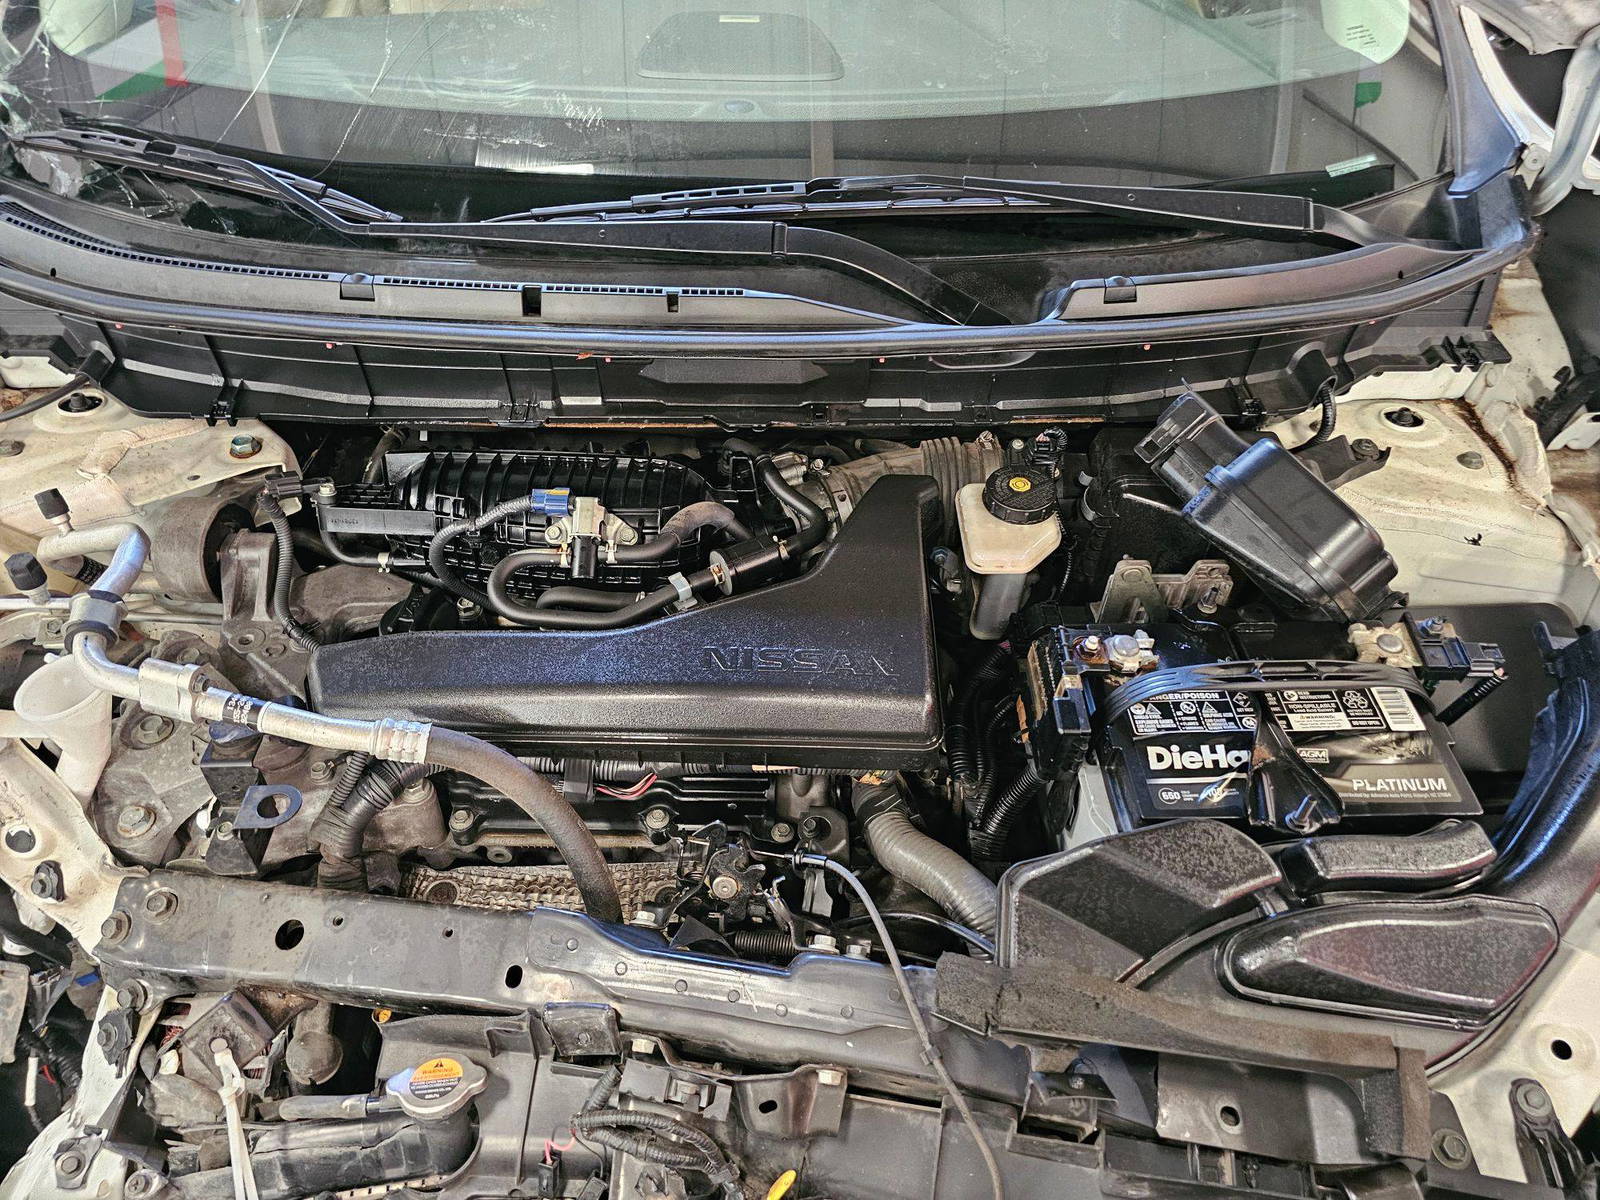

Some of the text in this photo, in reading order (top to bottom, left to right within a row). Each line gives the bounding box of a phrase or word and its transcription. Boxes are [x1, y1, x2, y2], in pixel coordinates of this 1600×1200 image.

[701, 646, 900, 676] NISSAN
[1149, 692, 1220, 701] ANGER/POISON
[1146, 744, 1249, 770] DieHa
[1299, 750, 1326, 758] AGM
[1352, 777, 1447, 791] PLATINUM
[1161, 791, 1181, 800] 650
